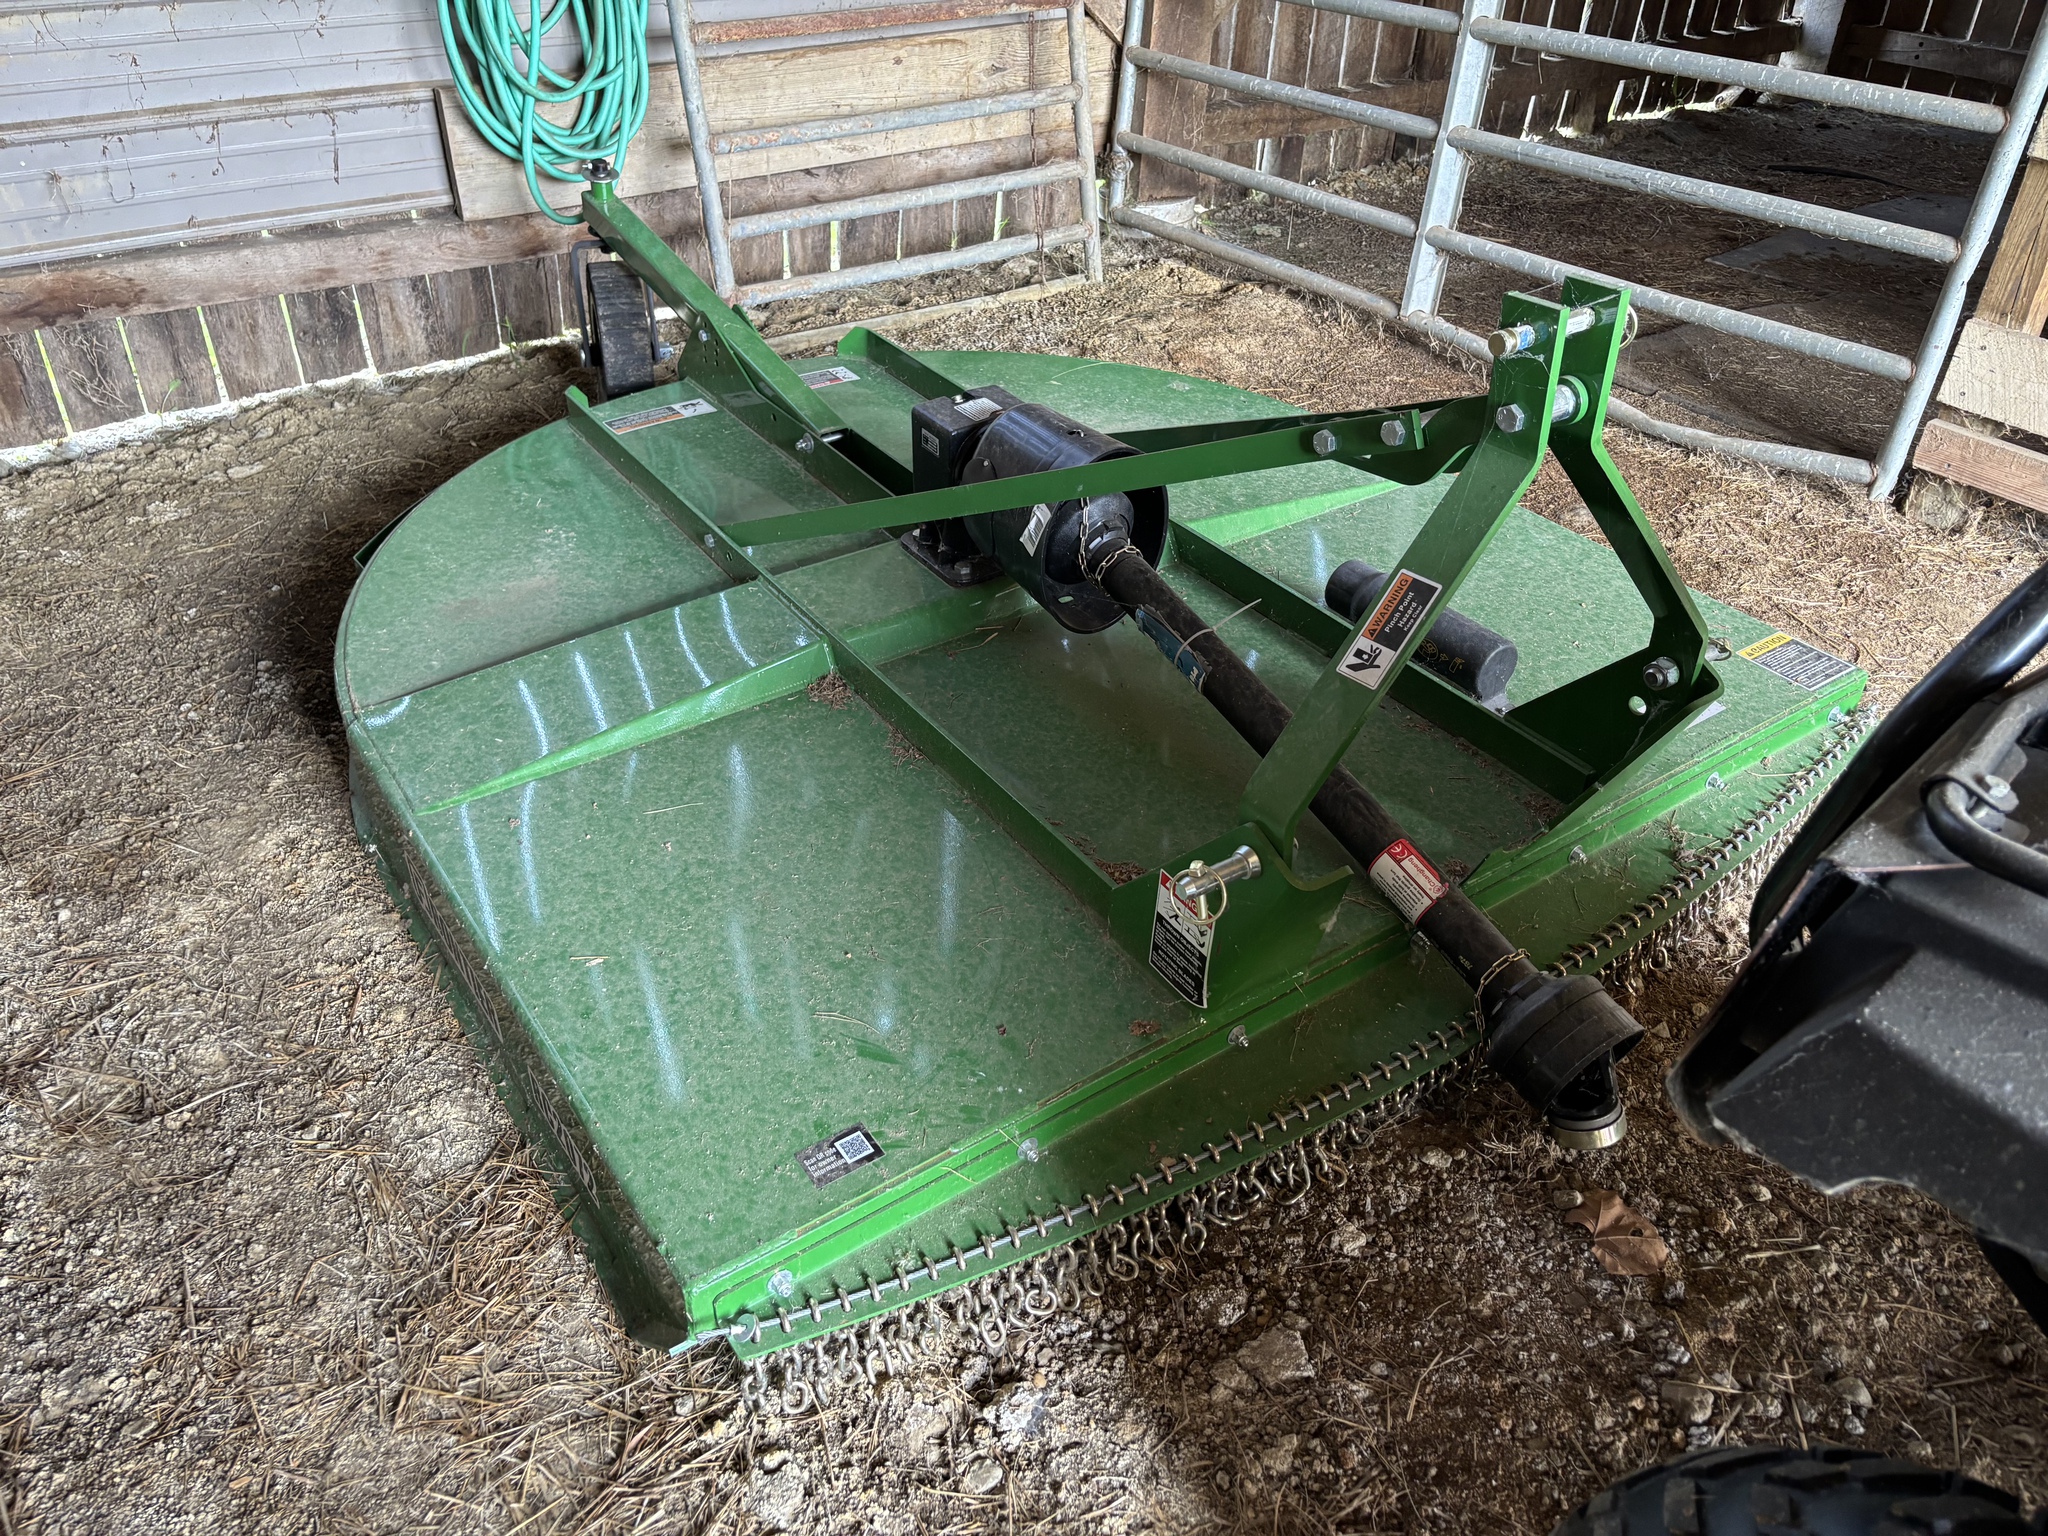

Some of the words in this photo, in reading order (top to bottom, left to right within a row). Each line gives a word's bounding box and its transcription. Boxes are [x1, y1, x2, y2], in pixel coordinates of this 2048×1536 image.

[1373, 578, 1409, 628] WARNING
[1384, 611, 1401, 633] Pinch
[1399, 591, 1415, 612] Point
[1397, 602, 1417, 628] Hazard
[1403, 617, 1414, 631] Keep
[1413, 605, 1423, 619] Clear
[1752, 635, 1787, 653] CAUTION
[405, 853, 502, 1042] FRONTIER
[1162, 920, 1180, 939] THROWN
[1180, 936, 1199, 957] OBJECTS
[1158, 949, 1178, 971] ROTATING
[1178, 968, 1195, 987] BLADES
[803, 1157, 817, 1166] Scan
[807, 1164, 817, 1172] for
[818, 1155, 837, 1168] owner
[812, 1159, 847, 1178] information
